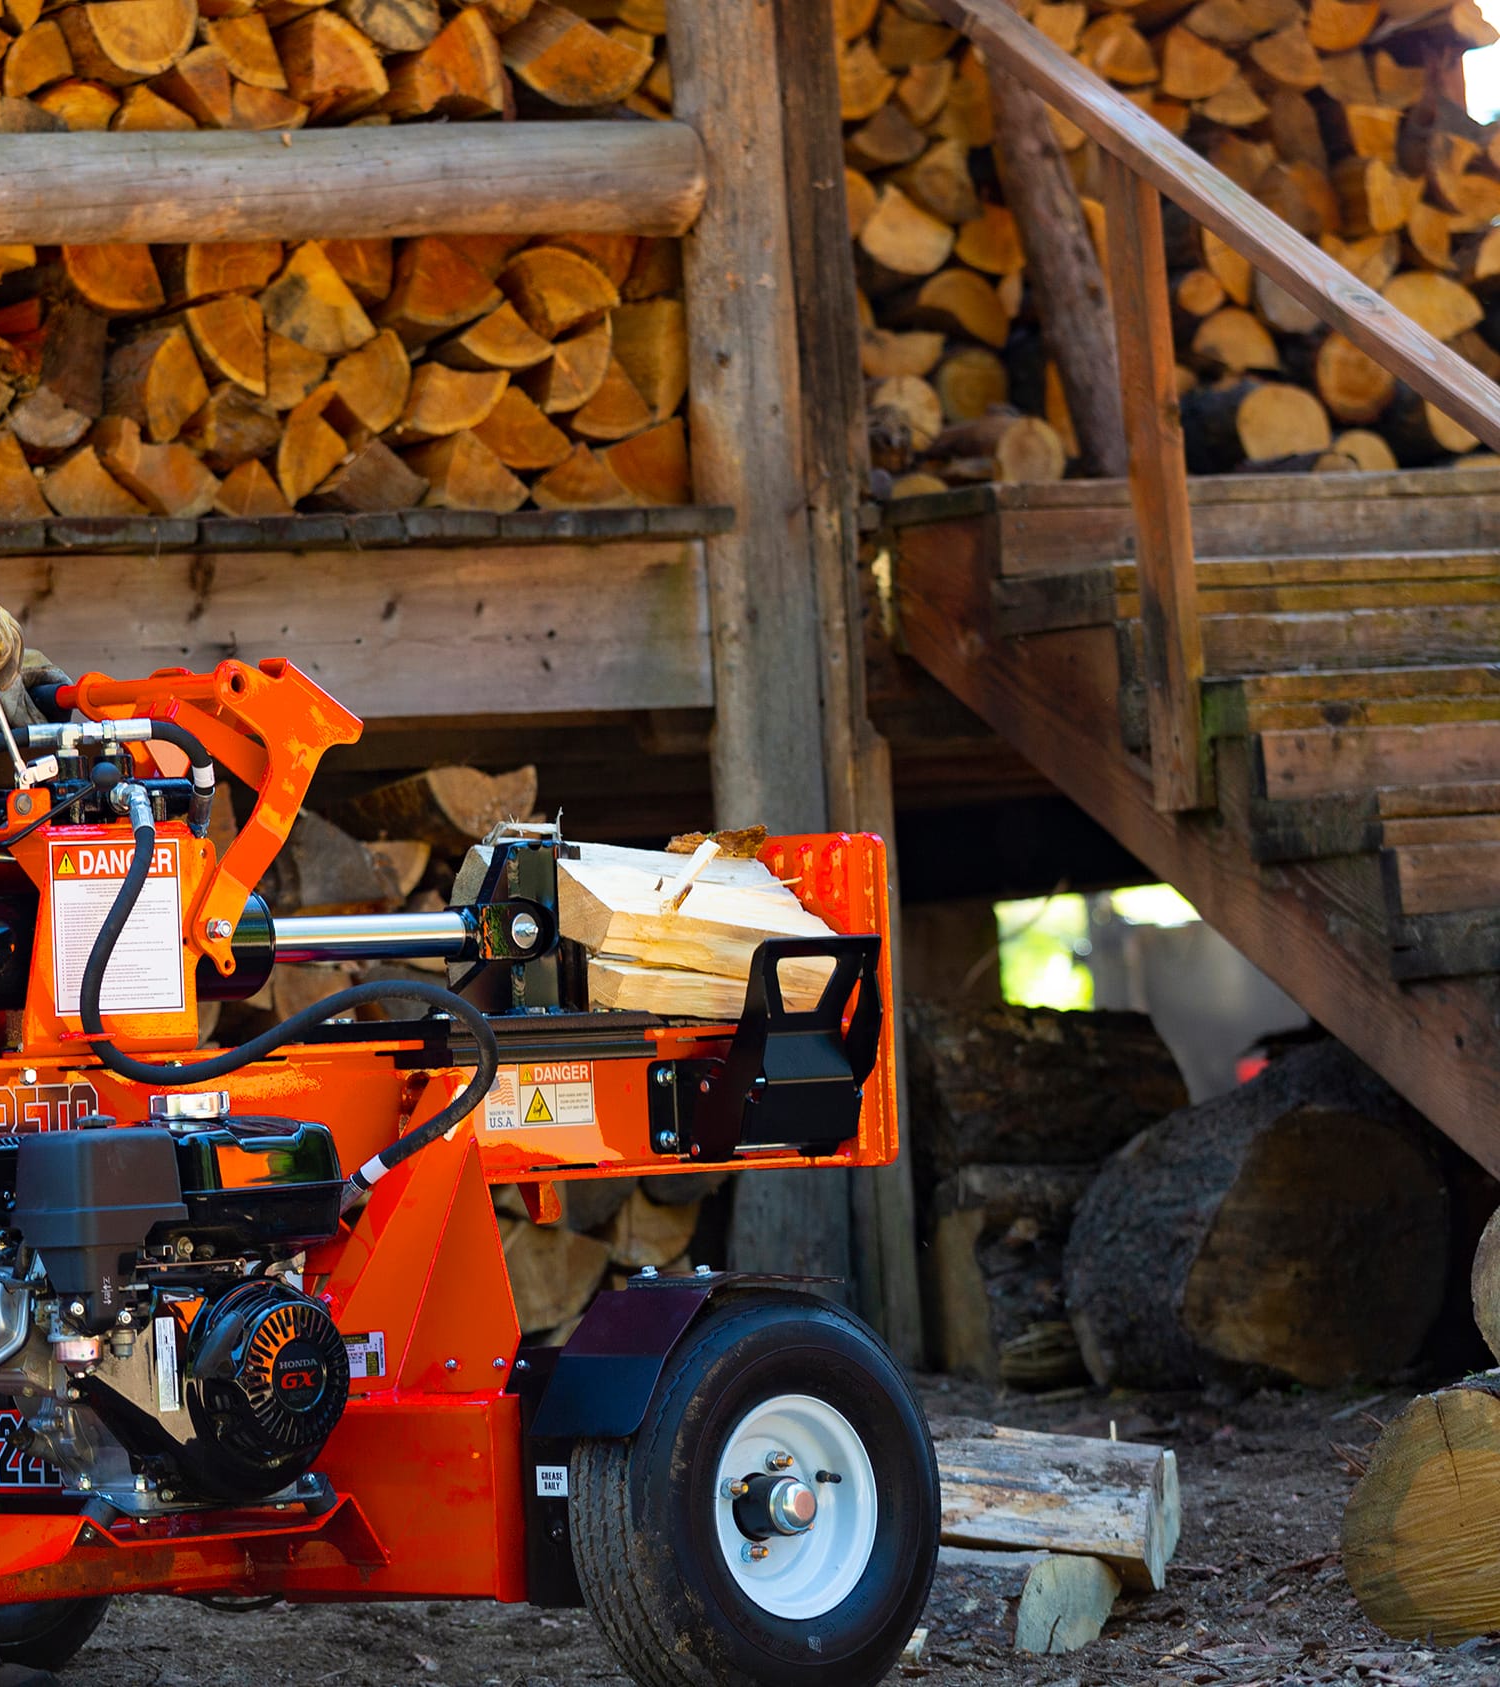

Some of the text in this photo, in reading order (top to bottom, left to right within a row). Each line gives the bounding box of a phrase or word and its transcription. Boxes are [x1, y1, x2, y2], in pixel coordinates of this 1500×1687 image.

[533, 1064, 589, 1082] DANGER
[489, 1116, 515, 1128] U.S.A.
[279, 1358, 319, 1370] HONDA
[280, 1370, 318, 1390] GX
[541, 1471, 563, 1480] GREASE
[544, 1481, 560, 1490] DAILY
